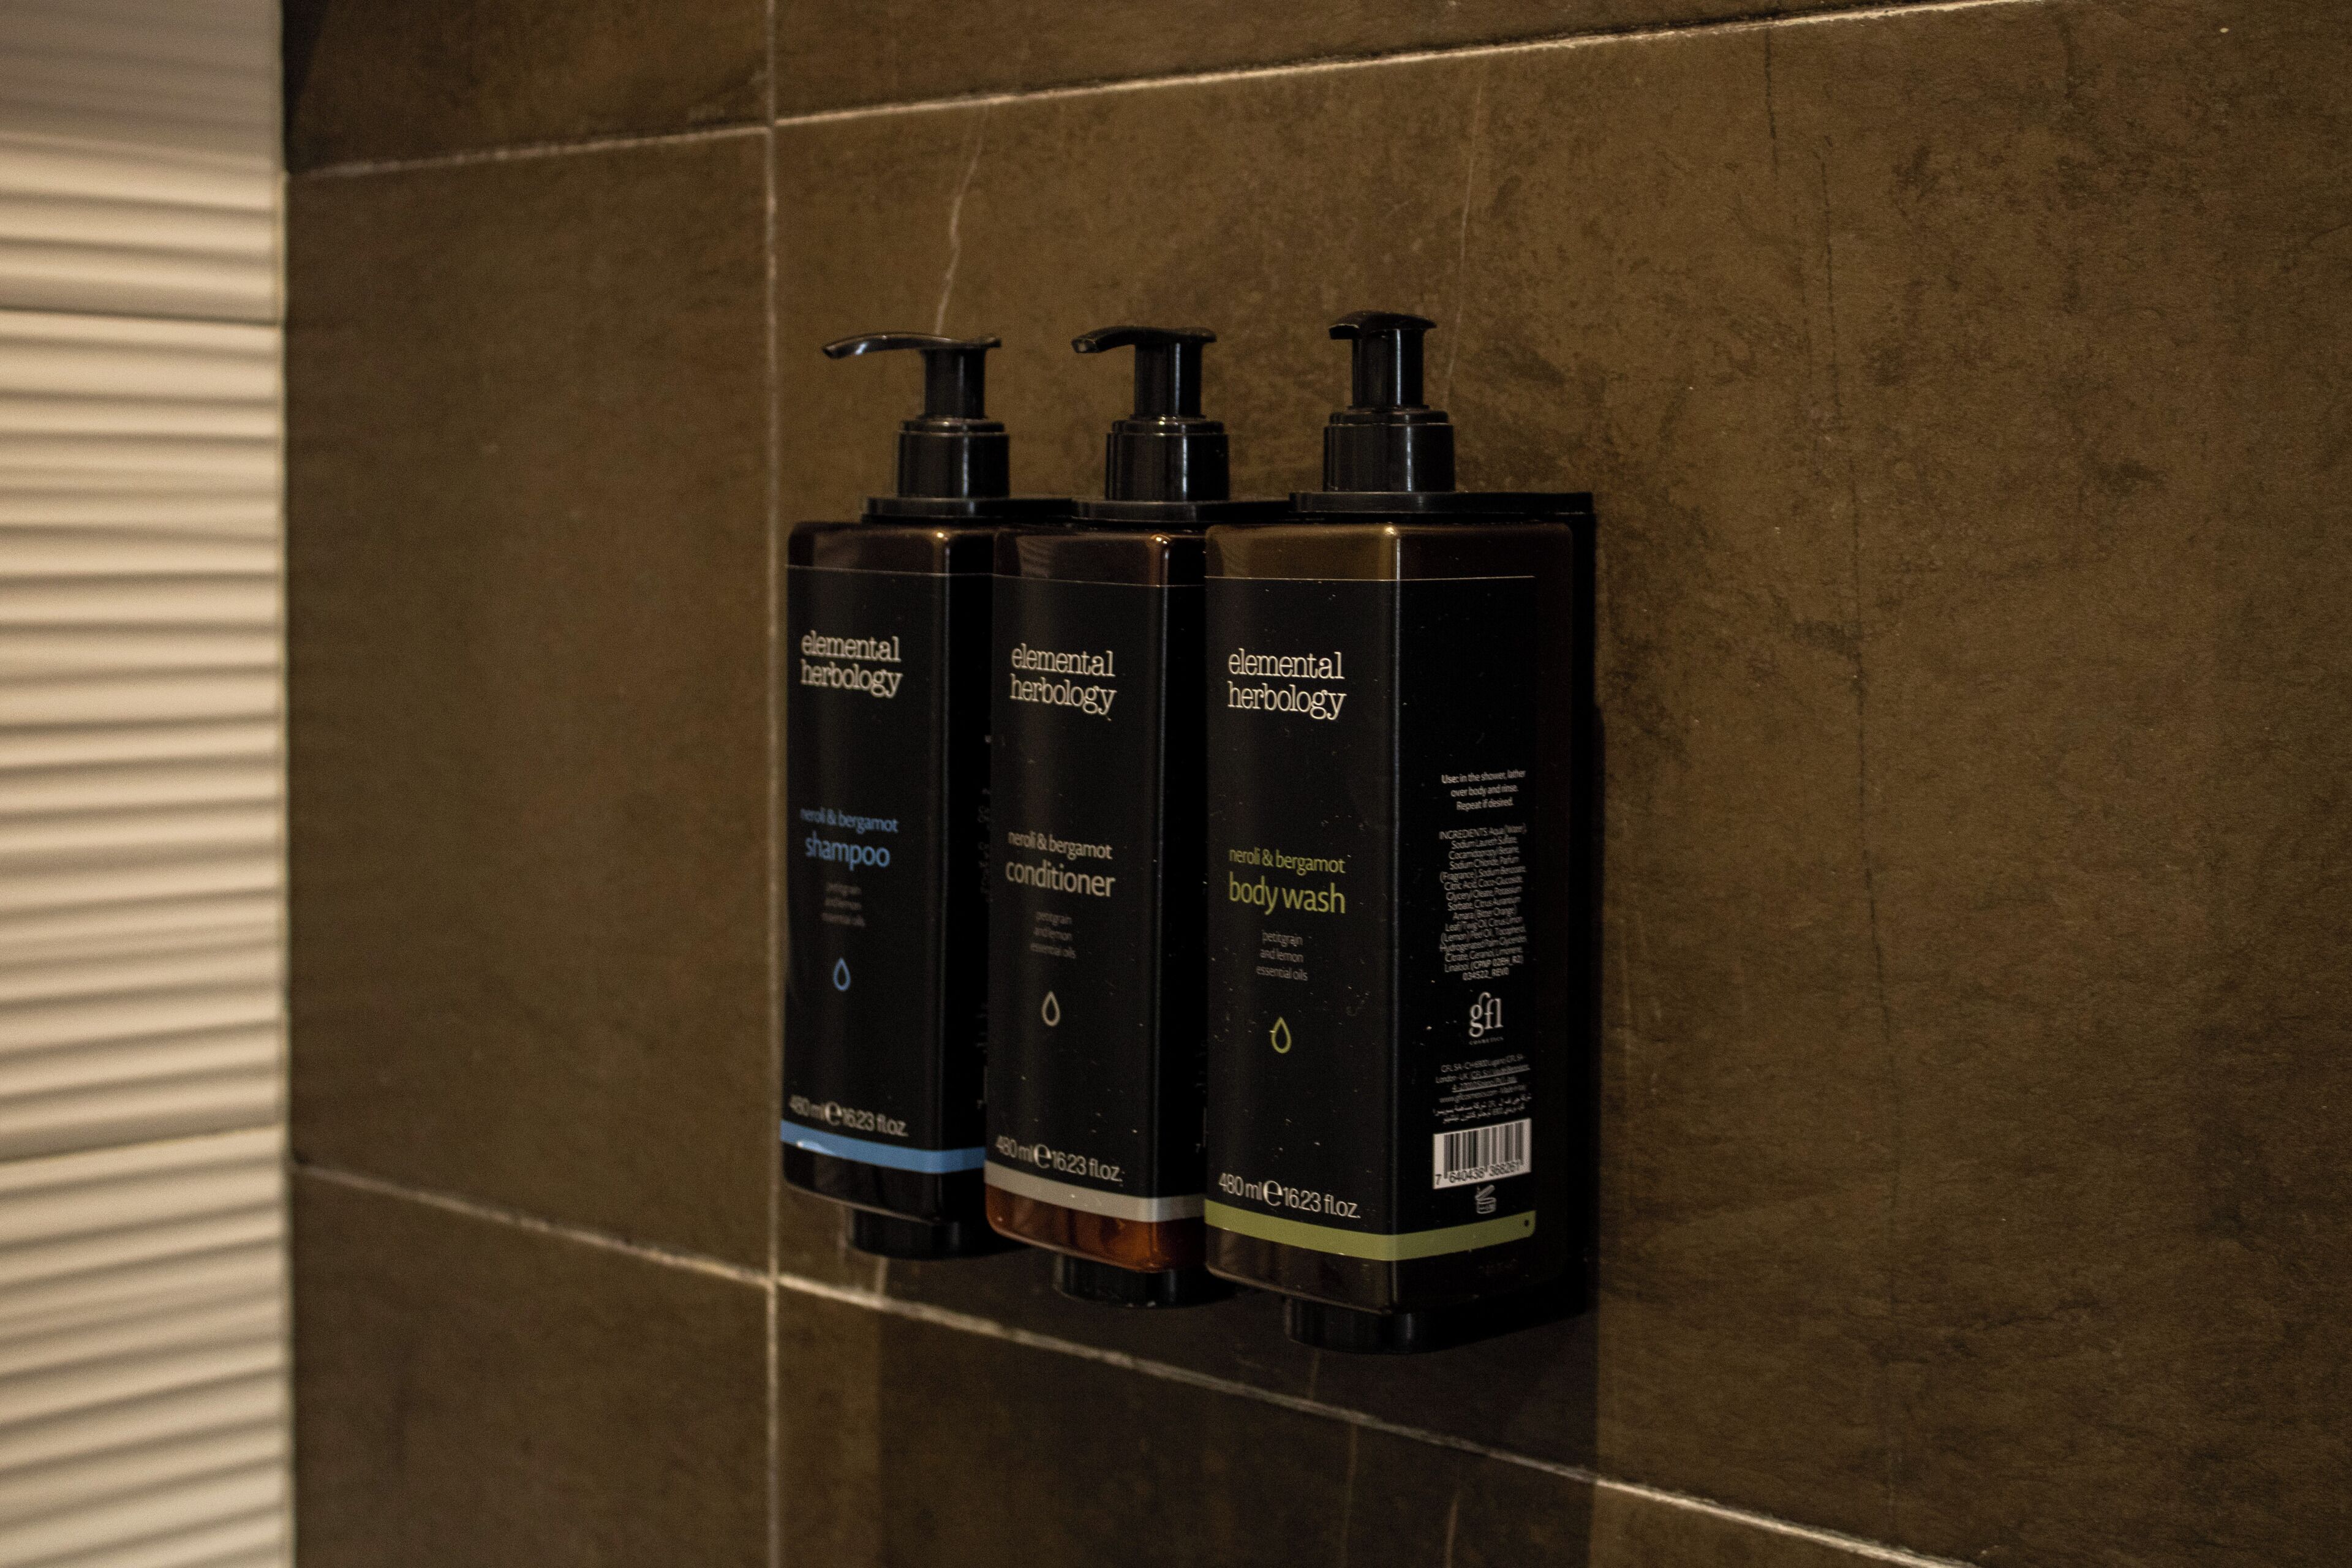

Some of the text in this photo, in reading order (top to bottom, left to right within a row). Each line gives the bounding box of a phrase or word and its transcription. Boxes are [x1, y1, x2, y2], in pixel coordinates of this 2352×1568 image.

[801, 629, 902, 663] elemental
[1012, 643, 1116, 677] elemental
[799, 658, 903, 699] herbology
[1229, 647, 1345, 679] elemental
[1009, 673, 1117, 715] herbology
[1227, 680, 1348, 720] herbology
[1468, 772, 1480, 782] the
[1468, 786, 1487, 797] body
[1487, 785, 1501, 794] and
[1456, 801, 1482, 812] Repeat
[838, 810, 899, 835] bergamot
[805, 830, 891, 872] shampoo
[1008, 831, 1113, 861] neroli & bergamot
[1229, 846, 1346, 876] neroli & bergamot
[1005, 859, 1117, 897] conditioner
[1229, 871, 1346, 915] body wash
[1256, 965, 1308, 981] essential oils
[1468, 991, 1504, 1038] gfl
[995, 1134, 1017, 1158] 480
[1218, 1172, 1245, 1196] 480
[1435, 1174, 1442, 1185] 7
